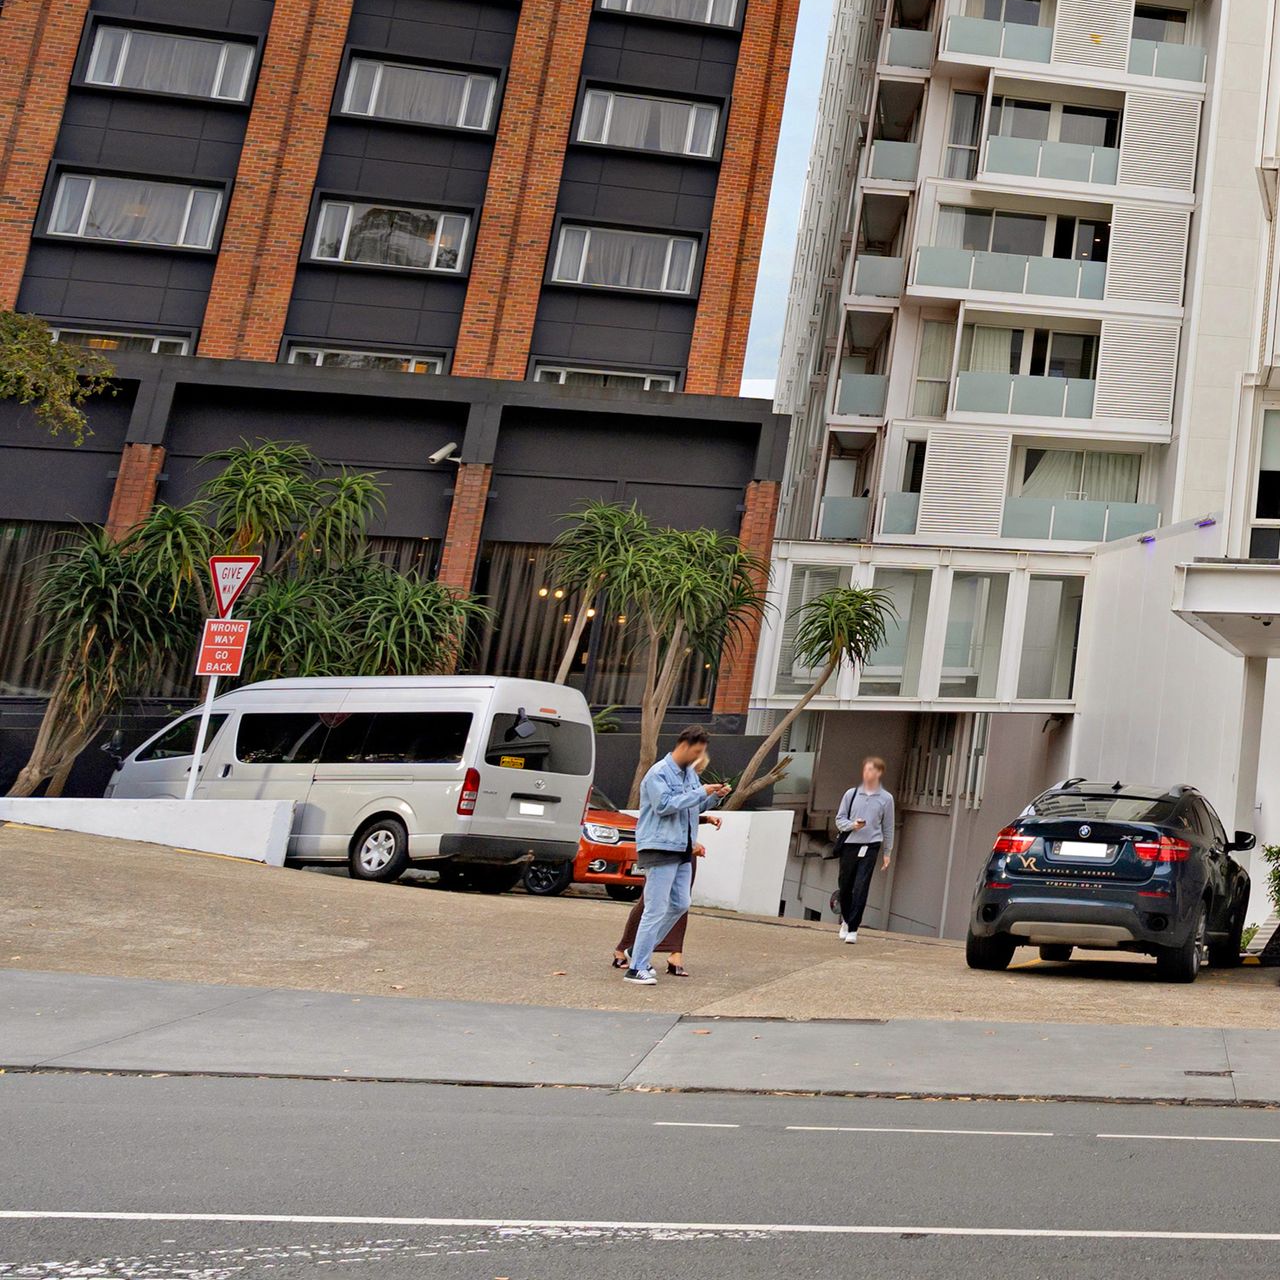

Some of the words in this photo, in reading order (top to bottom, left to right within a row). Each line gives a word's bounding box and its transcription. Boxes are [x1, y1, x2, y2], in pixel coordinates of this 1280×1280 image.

[222, 567, 243, 580] GIVE
[222, 585, 235, 593] WAY
[210, 623, 244, 633] WRONG
[214, 635, 236, 644] WAY
[215, 650, 228, 660] GO
[205, 662, 232, 672] BACK
[1018, 856, 1040, 871] VR
